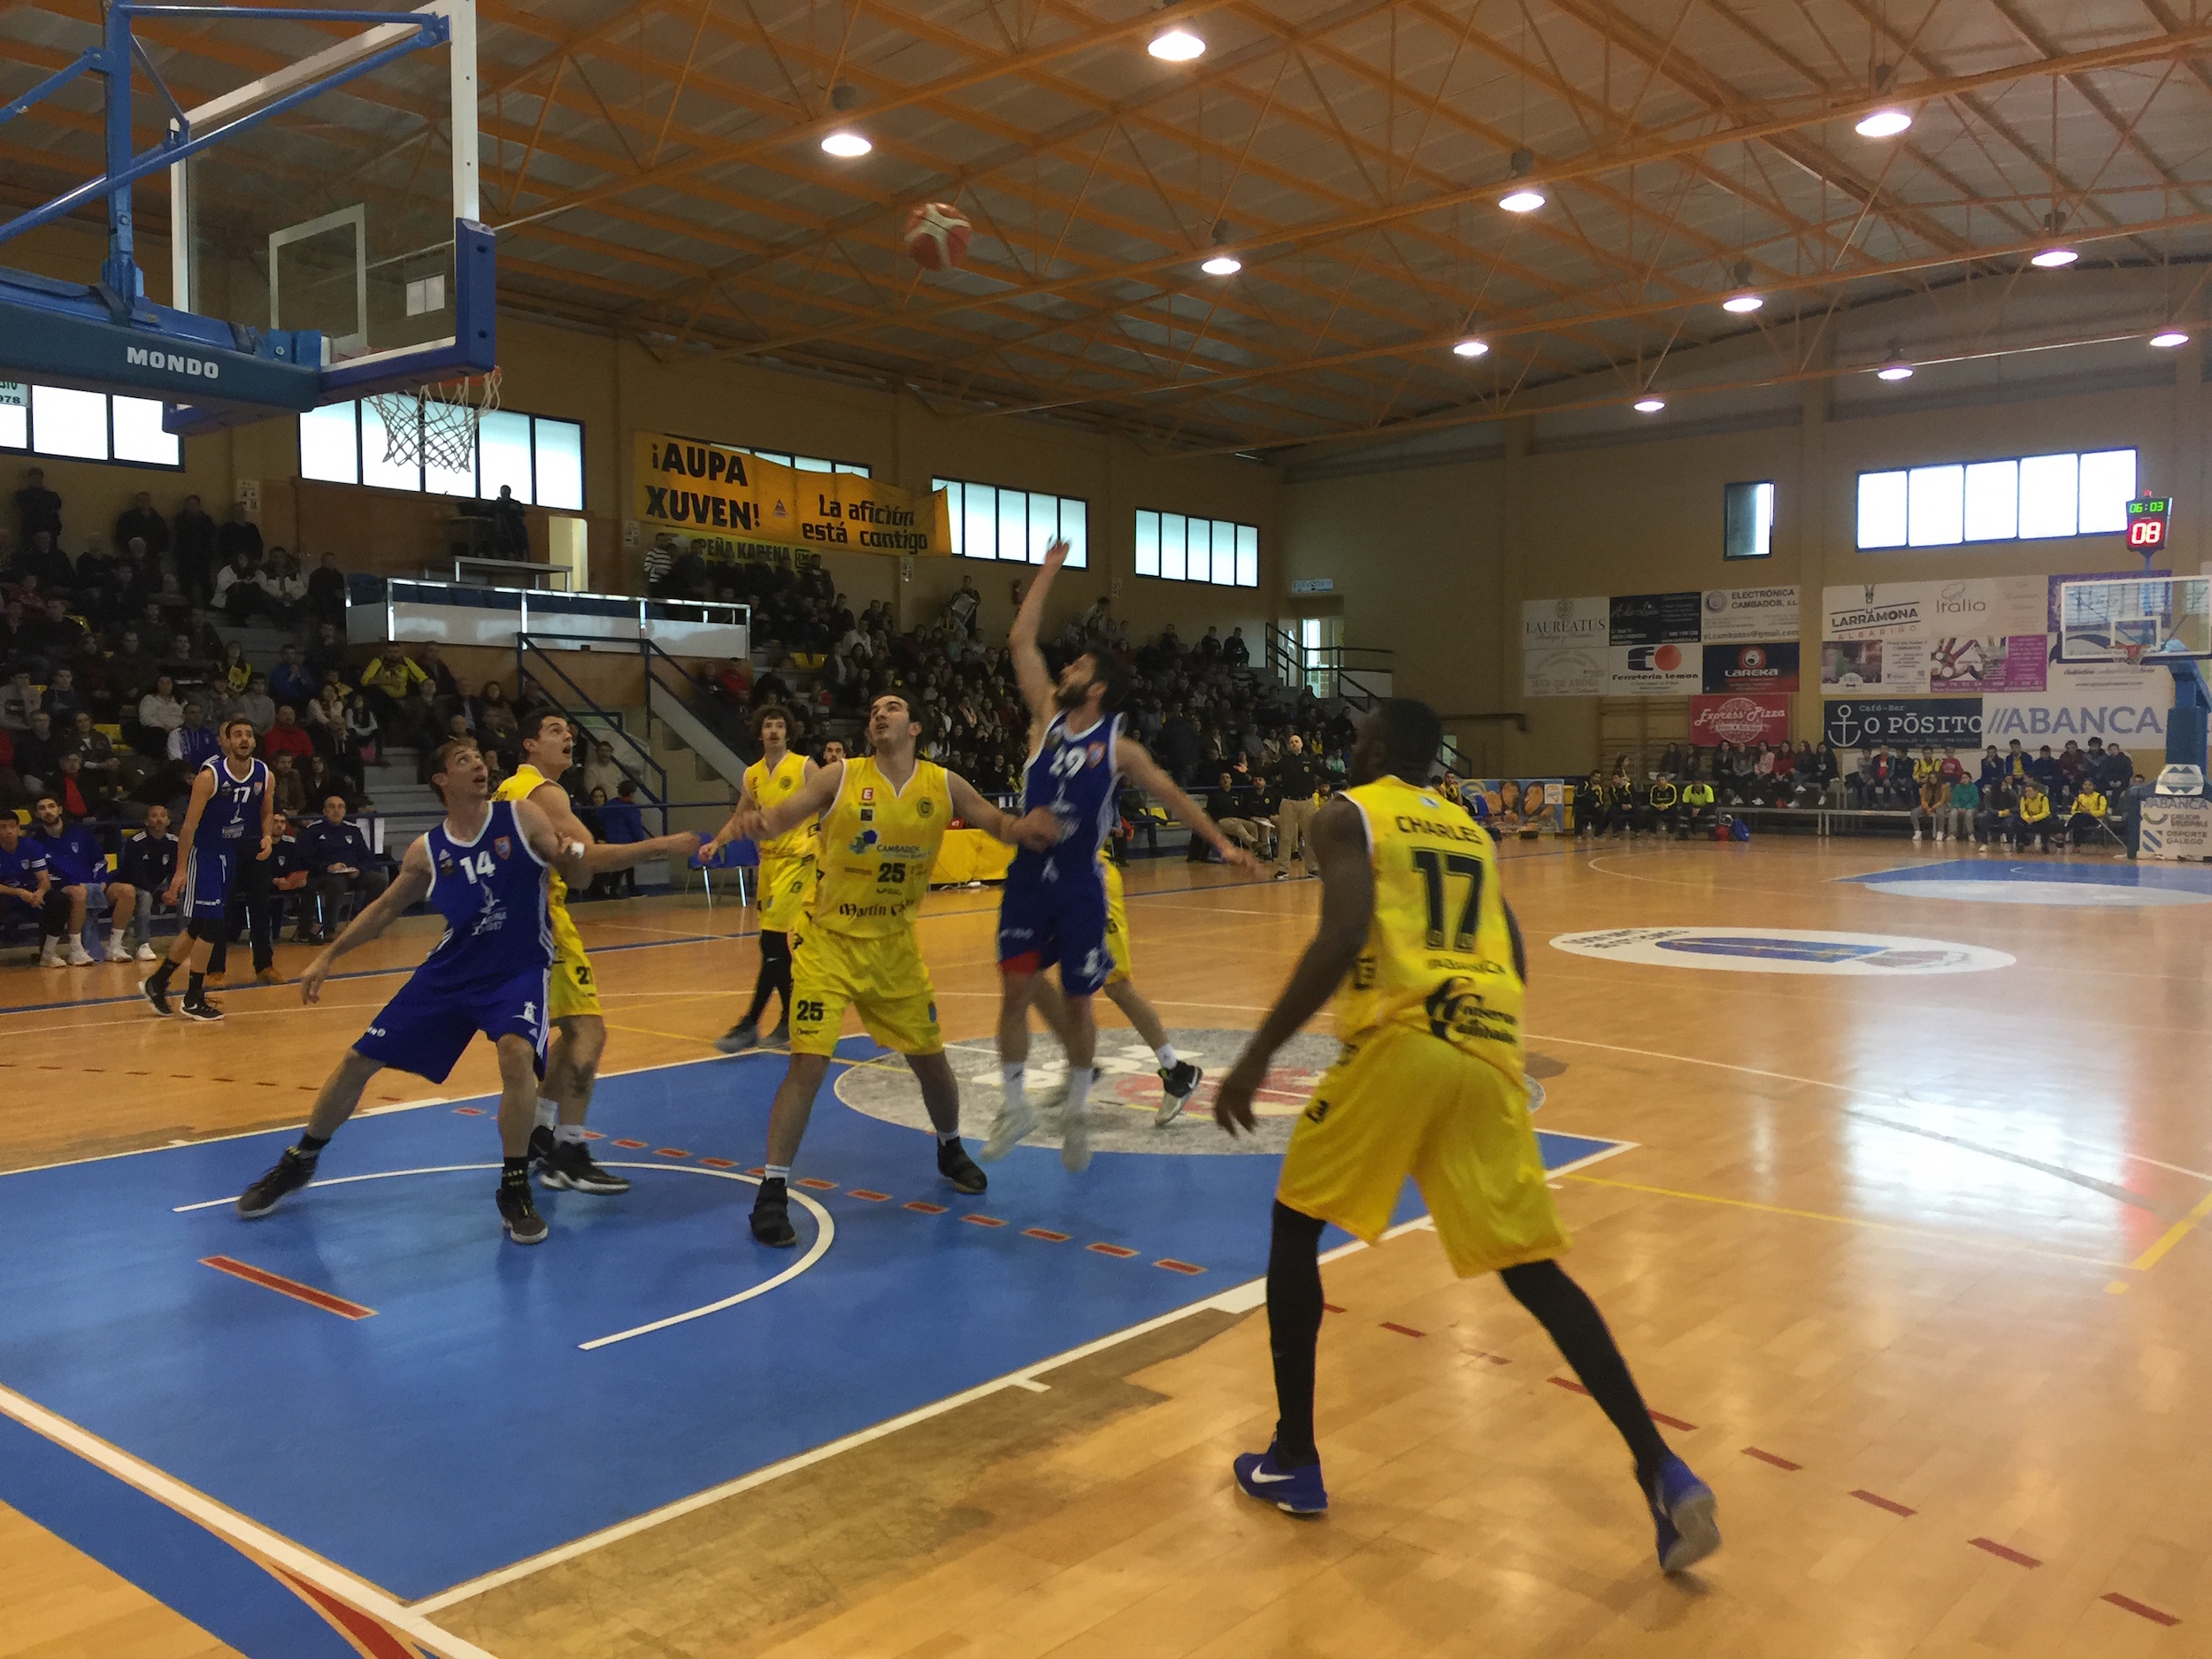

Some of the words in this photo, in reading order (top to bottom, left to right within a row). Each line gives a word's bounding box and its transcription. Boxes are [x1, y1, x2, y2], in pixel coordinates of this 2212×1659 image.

[127, 346, 219, 379] MONDO
[645, 485, 760, 530] XUVEN!
[818, 494, 841, 518] La
[849, 499, 915, 526] afición
[2130, 501, 2164, 513] 06:03
[802, 520, 849, 544] está
[860, 528, 928, 555] contigo
[2131, 521, 2161, 544] 08
[1525, 618, 1606, 634] LAUREATUS
[1832, 608, 1918, 627] LARRAMONA
[1694, 708, 1744, 726] Express
[1747, 706, 1786, 722] Pizza
[1863, 717, 1881, 734] O
[233, 786, 251, 803] 17
[1395, 815, 1483, 845] CHARLES
[459, 849, 496, 885] 14
[878, 863, 906, 883] 25
[1409, 847, 1486, 953] 17
[796, 1000, 824, 1021] 25
